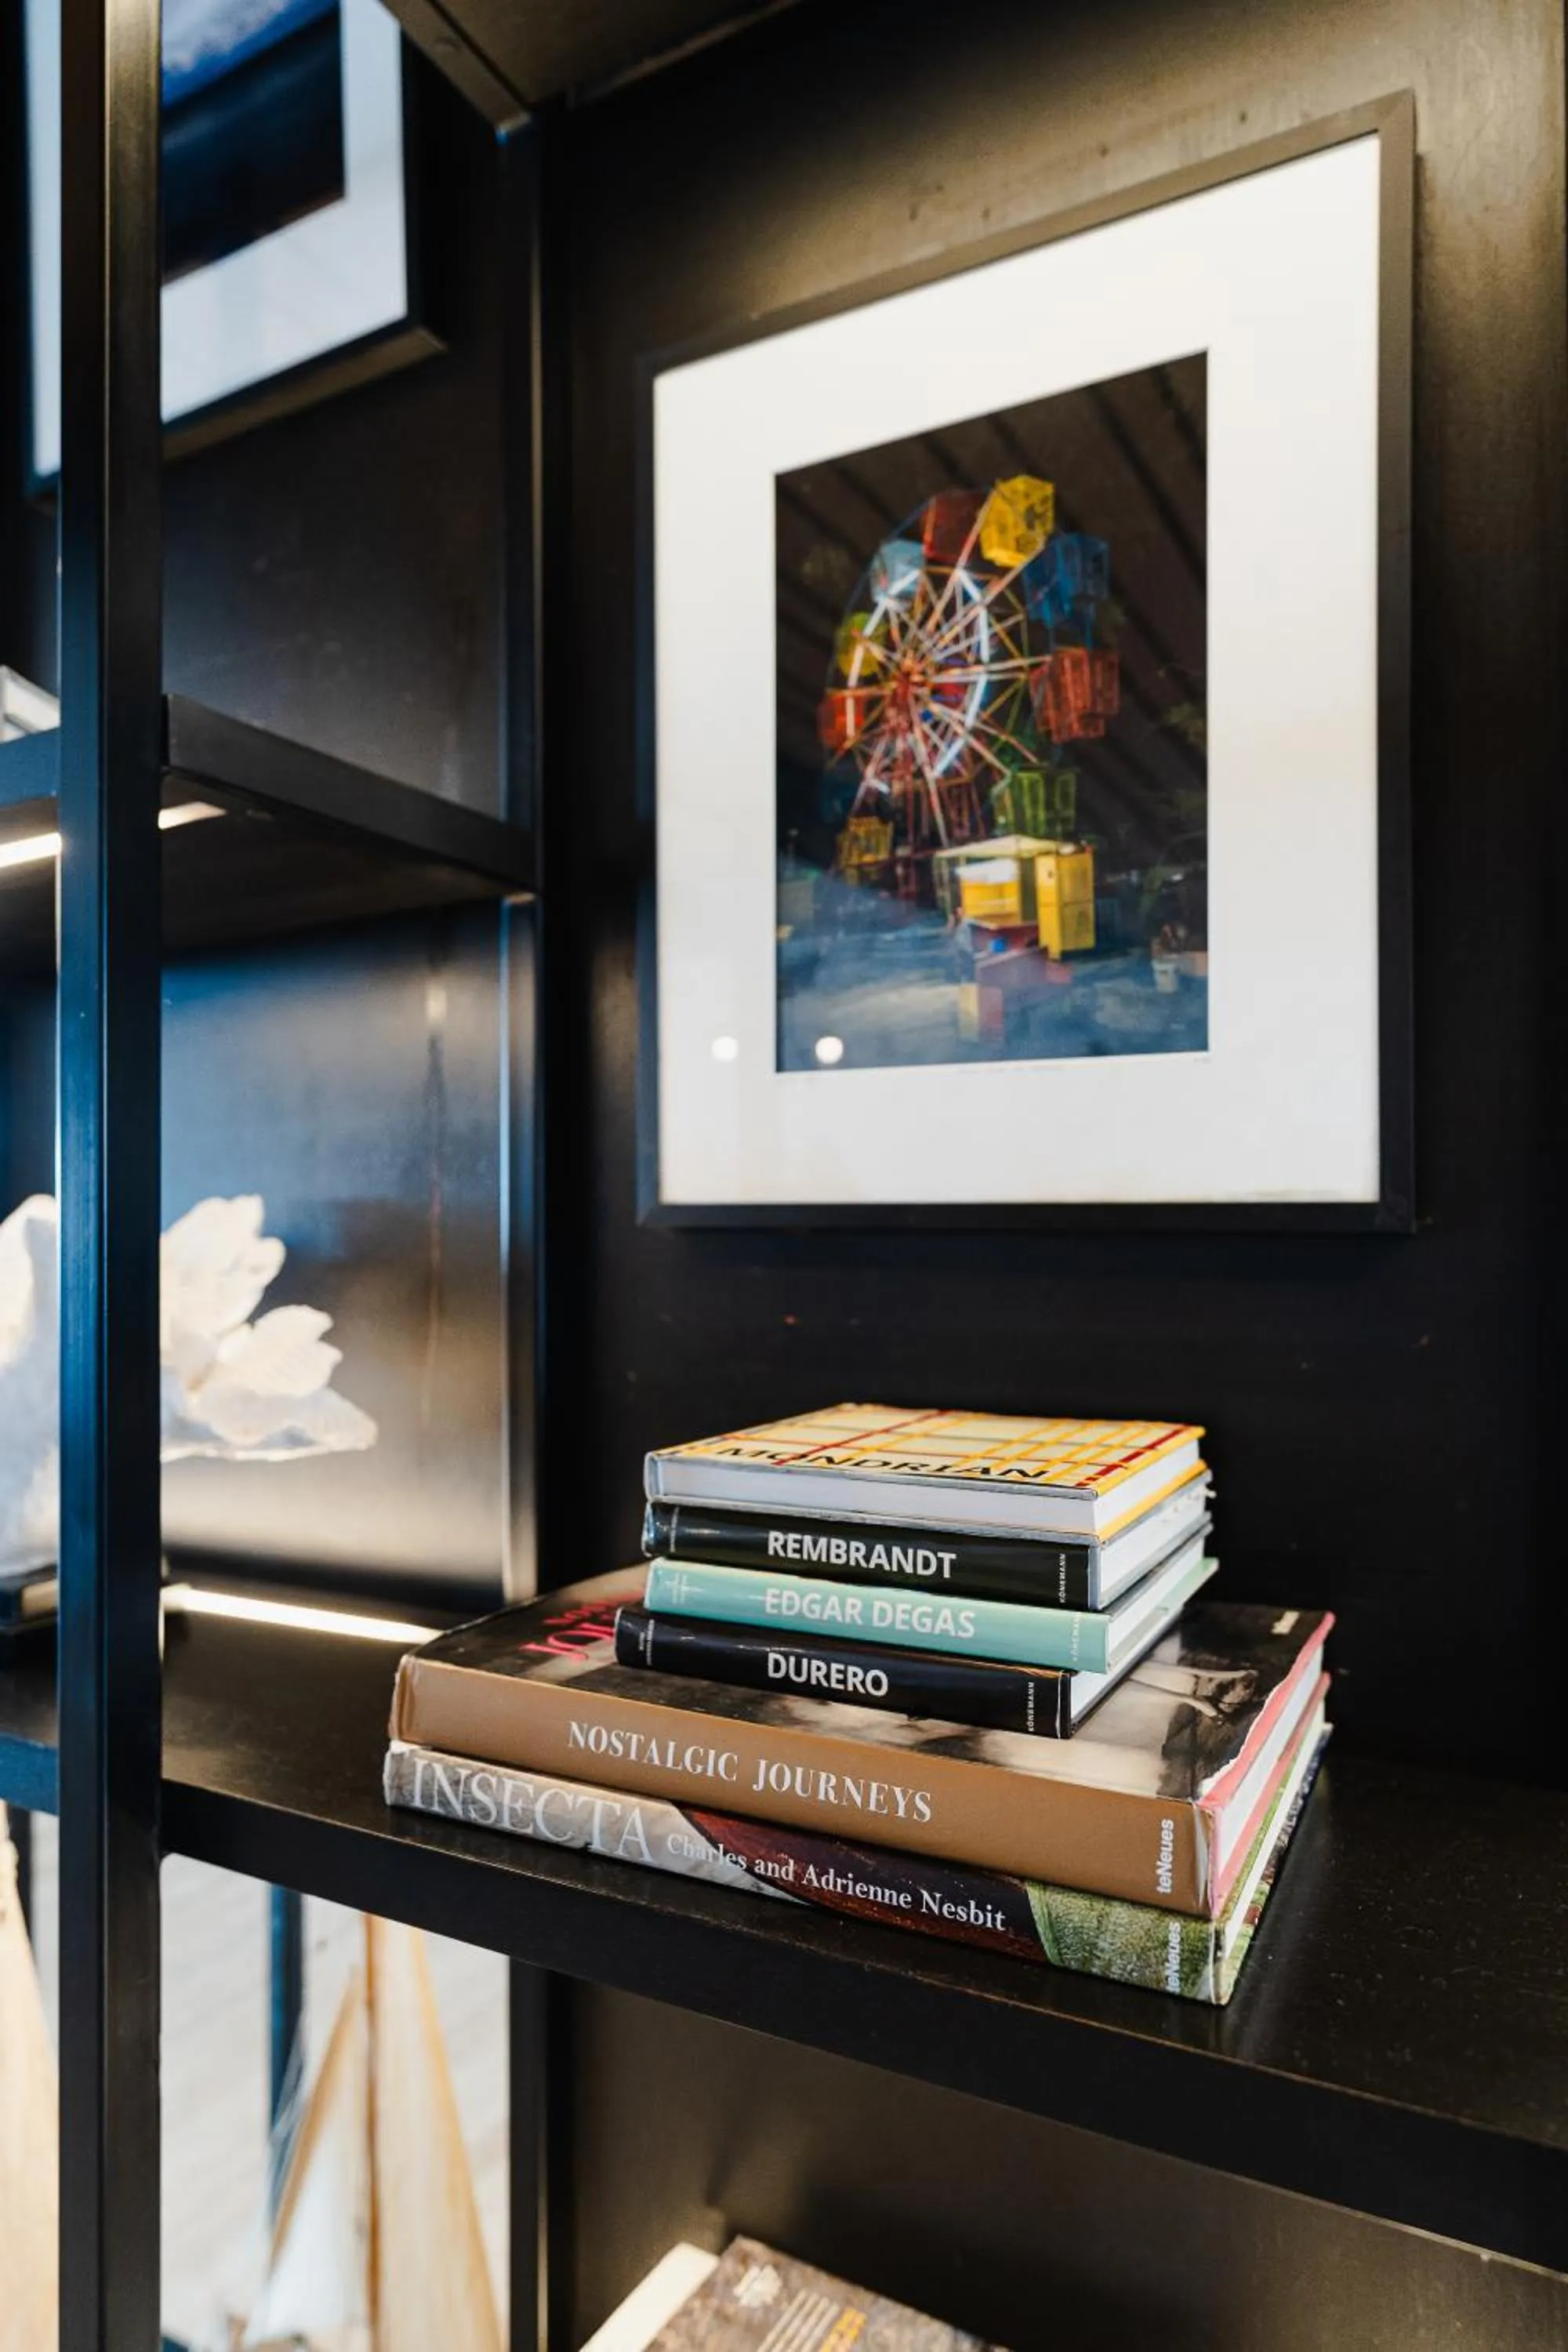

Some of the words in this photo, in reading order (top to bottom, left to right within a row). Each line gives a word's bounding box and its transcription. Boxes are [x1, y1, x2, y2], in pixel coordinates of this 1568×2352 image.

[717, 1446, 1049, 1479] MONDRIAN
[768, 1530, 956, 1579] REMBRANDT
[764, 1588, 862, 1626] EDGAR
[872, 1601, 975, 1639] DEGAS
[767, 1653, 889, 1698] DURERO
[566, 1721, 739, 1781] NOSTALGIC
[752, 1759, 932, 1823] JOURNEYS
[410, 1757, 657, 1864] INSECTA
[666, 1832, 746, 1871] Charles
[753, 1853, 794, 1882] and
[801, 1864, 912, 1909] Adrienne
[920, 1890, 1007, 1931] Nesbit
[1156, 1818, 1174, 1894] teNeues
[1165, 1922, 1181, 1992] teNeues
